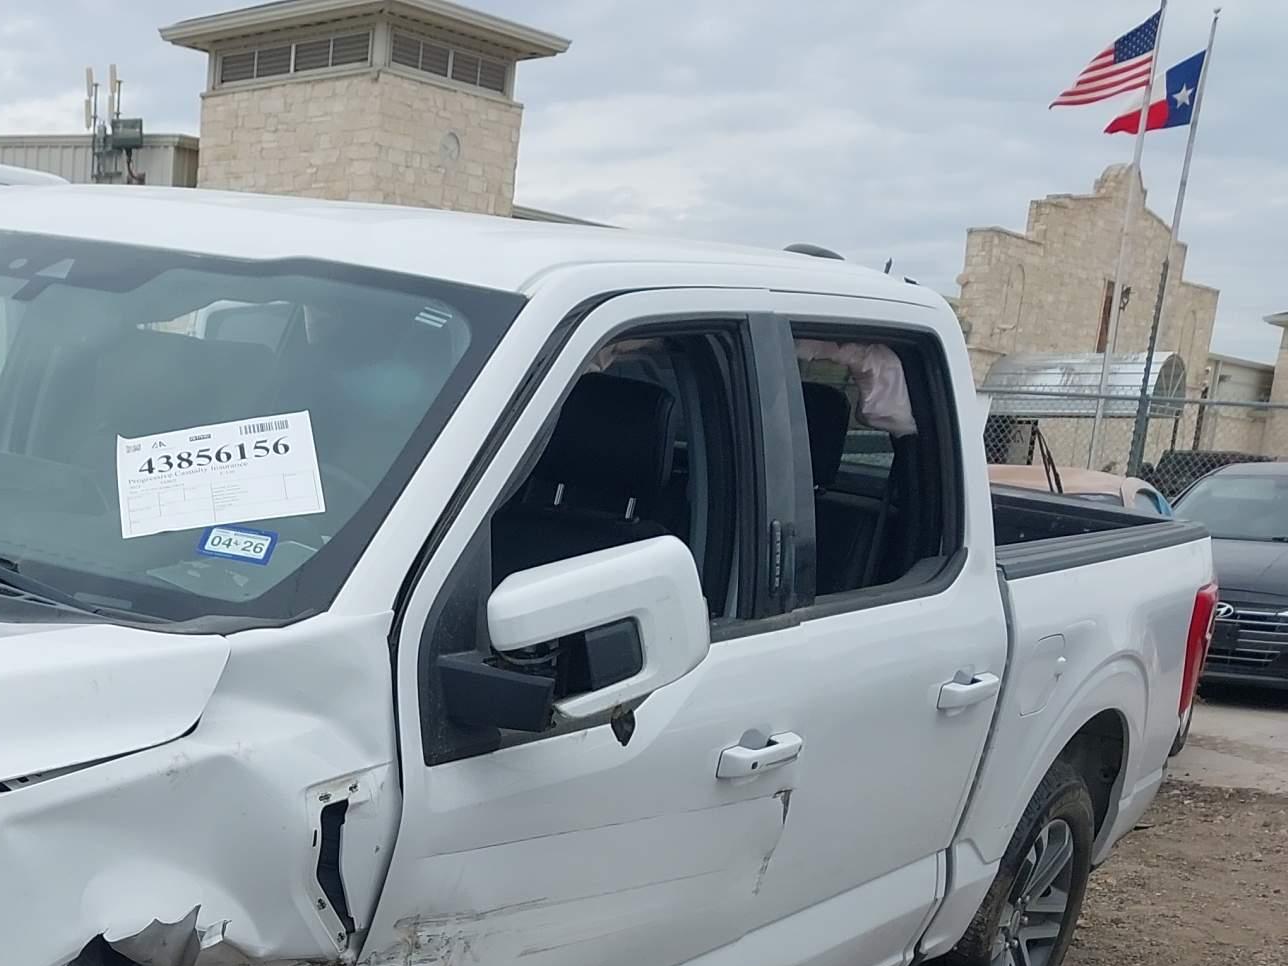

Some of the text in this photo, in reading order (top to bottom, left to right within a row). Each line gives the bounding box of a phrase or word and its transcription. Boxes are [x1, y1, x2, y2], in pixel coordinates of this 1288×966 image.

[139, 436, 290, 475] 43856156
[210, 535, 266, 554] 04 26
